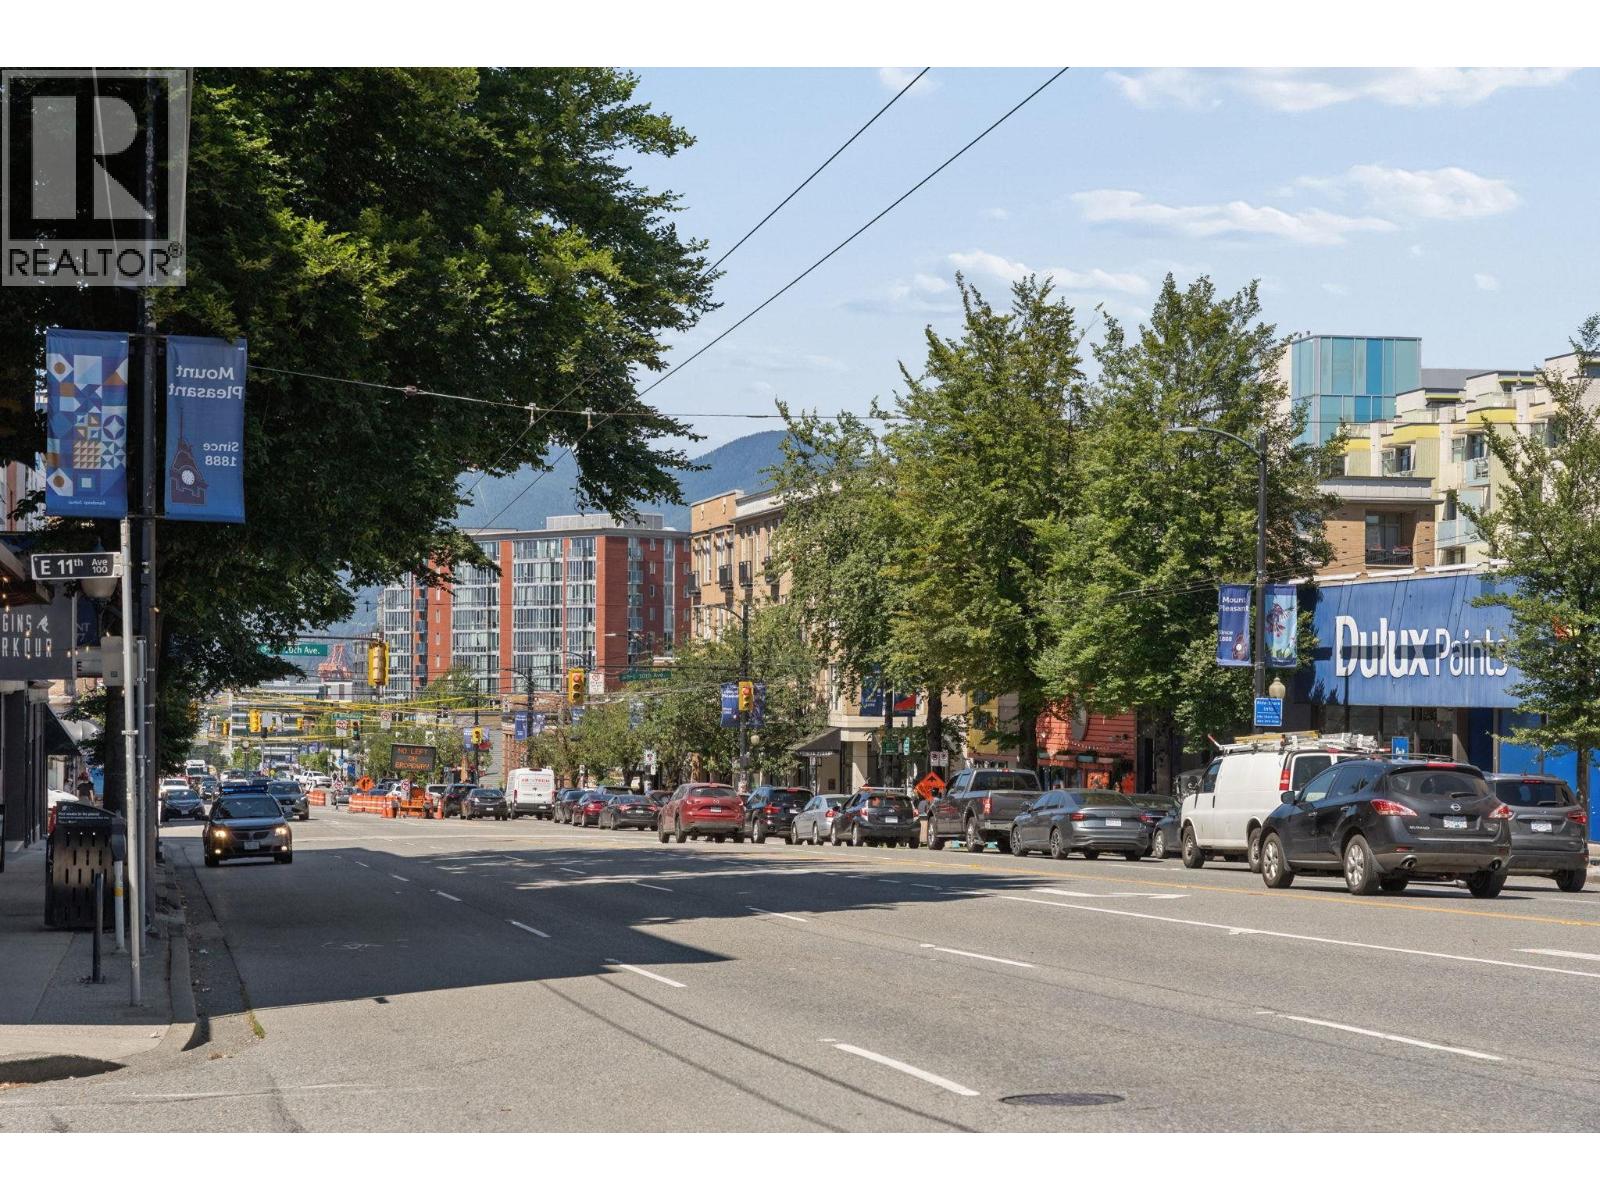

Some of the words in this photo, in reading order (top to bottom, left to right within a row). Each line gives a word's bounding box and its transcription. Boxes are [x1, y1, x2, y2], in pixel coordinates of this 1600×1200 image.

[41, 559, 51, 575] E
[57, 558, 83, 575] 11th
[91, 558, 108, 567] Ave
[92, 565, 108, 574] 100
[1335, 615, 1430, 679] Dulux
[1434, 628, 1510, 678] Paints
